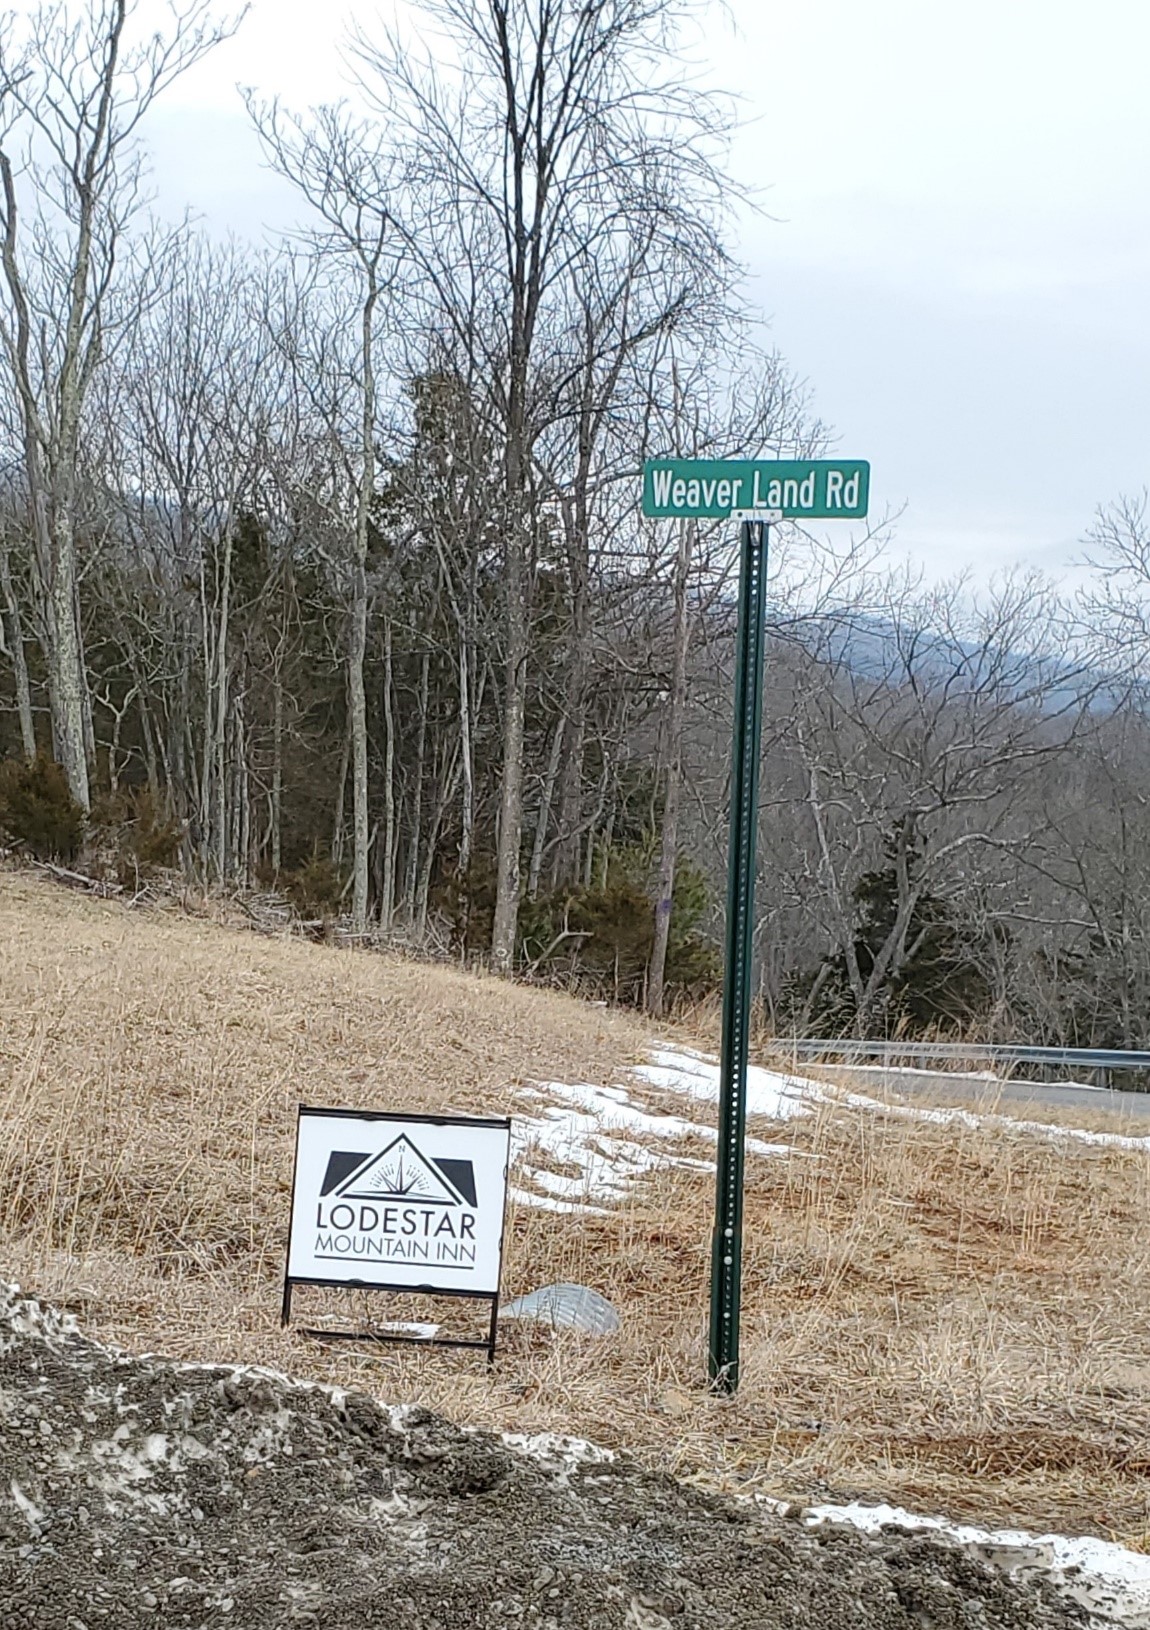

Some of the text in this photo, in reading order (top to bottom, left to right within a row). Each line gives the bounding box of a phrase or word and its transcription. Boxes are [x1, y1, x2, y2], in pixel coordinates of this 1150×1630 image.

[652, 470, 859, 508] Weaver Land Rd
[316, 1203, 476, 1240] LODESTAR
[314, 1233, 476, 1262] MOUNTAIN INN
